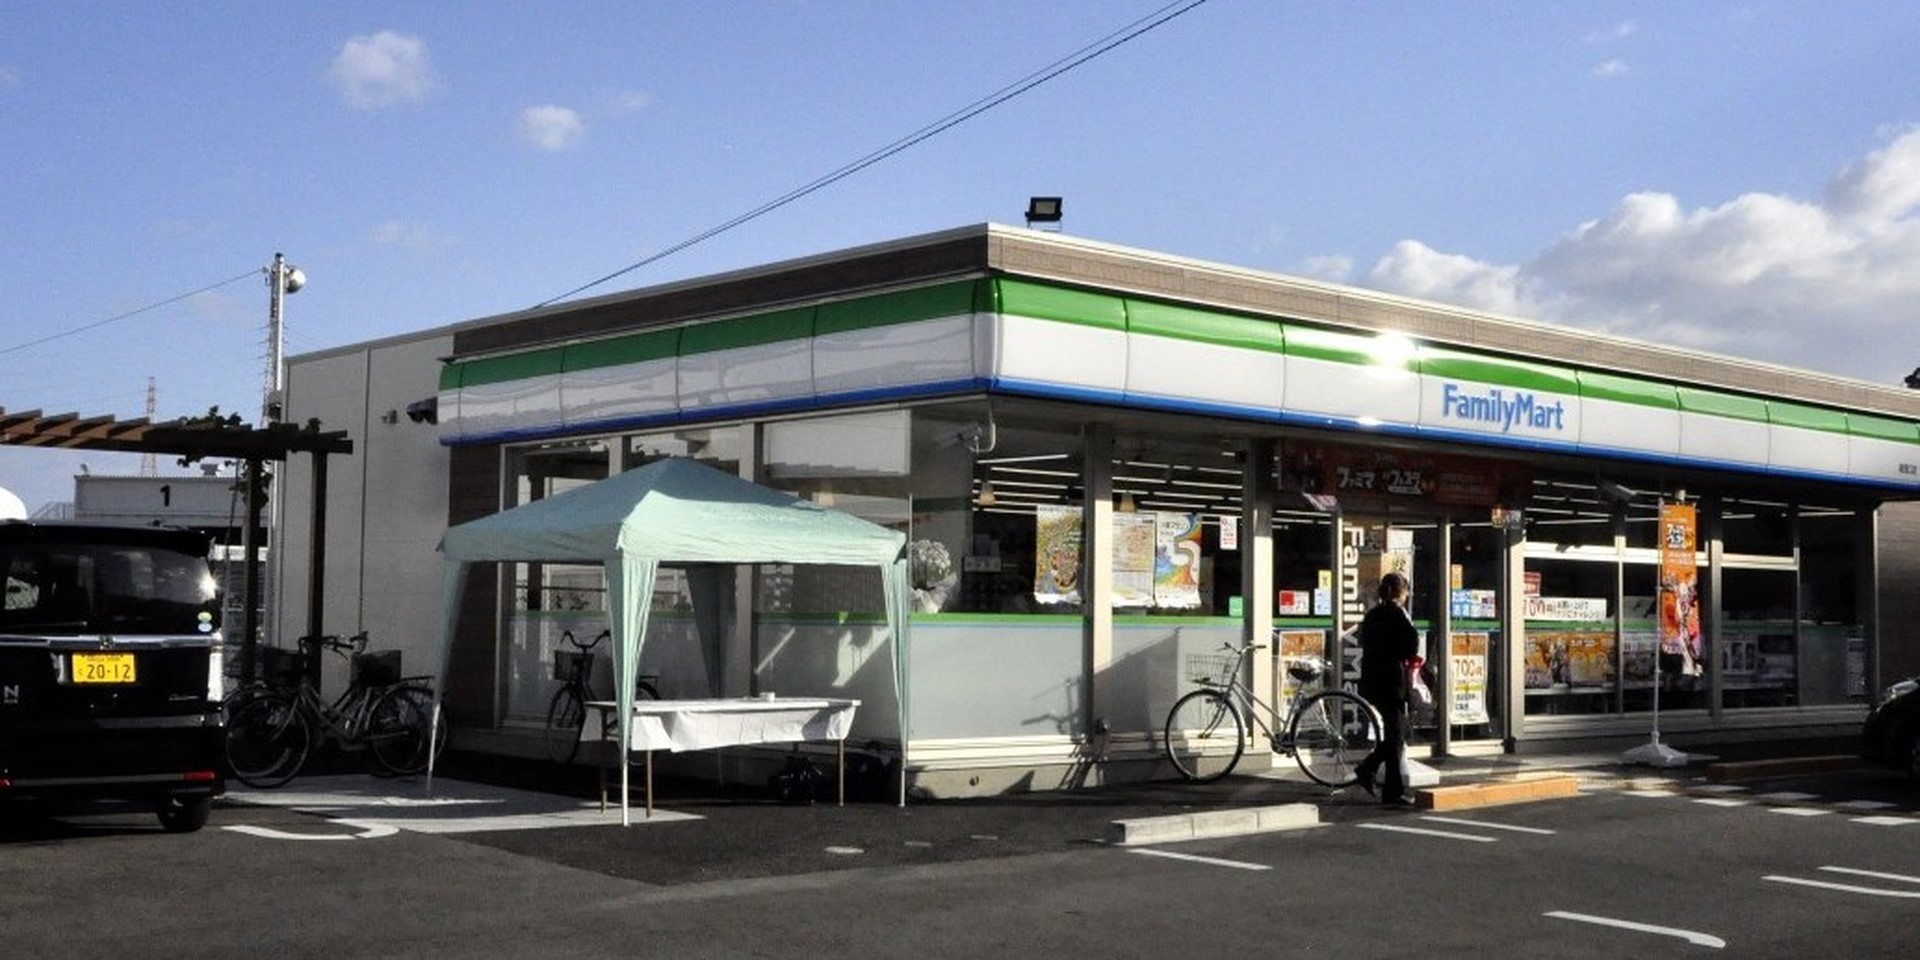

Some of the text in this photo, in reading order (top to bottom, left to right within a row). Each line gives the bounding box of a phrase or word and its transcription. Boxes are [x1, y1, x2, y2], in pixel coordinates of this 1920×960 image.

[1442, 383, 1564, 432] FamilyMart
[160, 484, 171, 507] 1
[87, 664, 131, 680] 20-12
[3, 684, 20, 699] N
